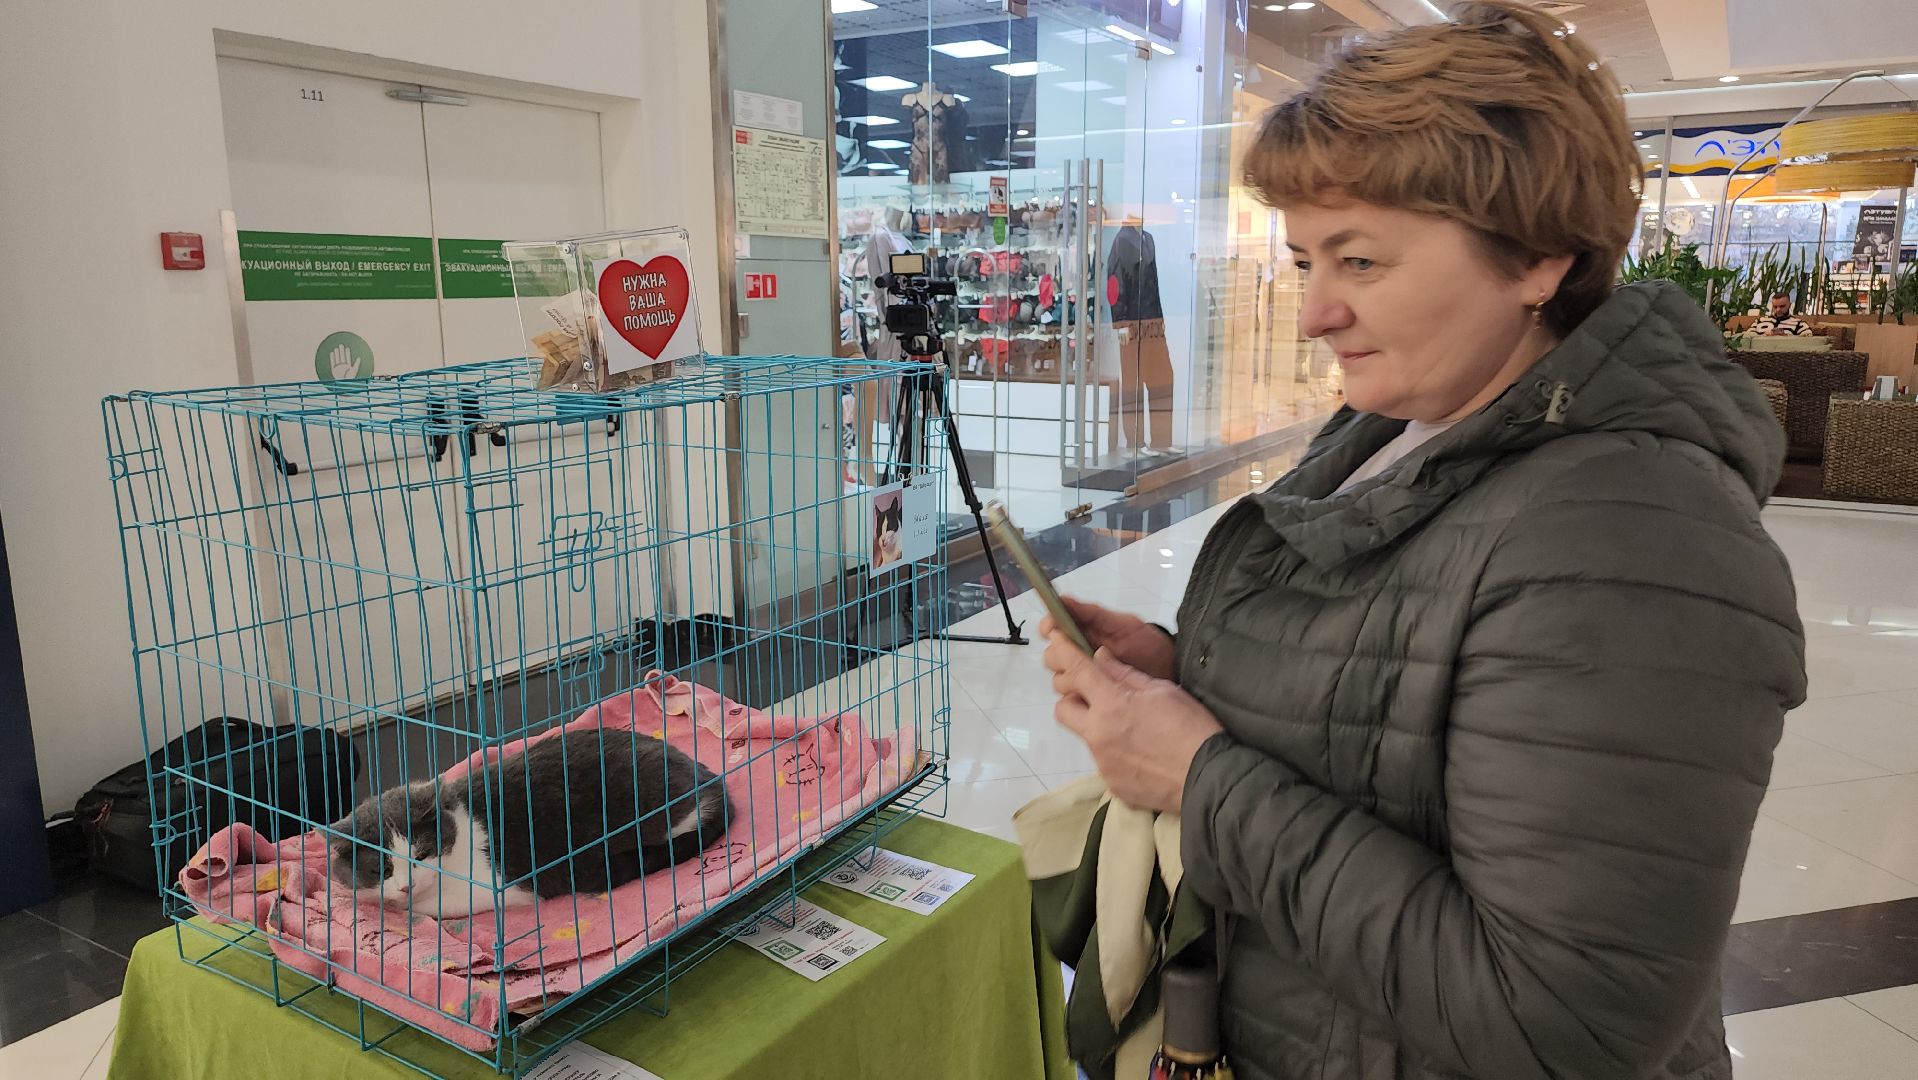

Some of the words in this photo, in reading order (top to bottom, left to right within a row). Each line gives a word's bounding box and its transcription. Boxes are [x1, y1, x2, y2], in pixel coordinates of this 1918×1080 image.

[300, 88, 325, 102] 1.11
[241, 258, 312, 271] КУАЦИОННЫЙ
[315, 260, 351, 272] ВЫХОД
[358, 262, 411, 272] EMERGENCY
[413, 262, 431, 272] EXIT
[621, 272, 667, 293] НУЖНА
[628, 291, 666, 311] ВАША
[623, 308, 676, 331] ПОМОЩЬ
